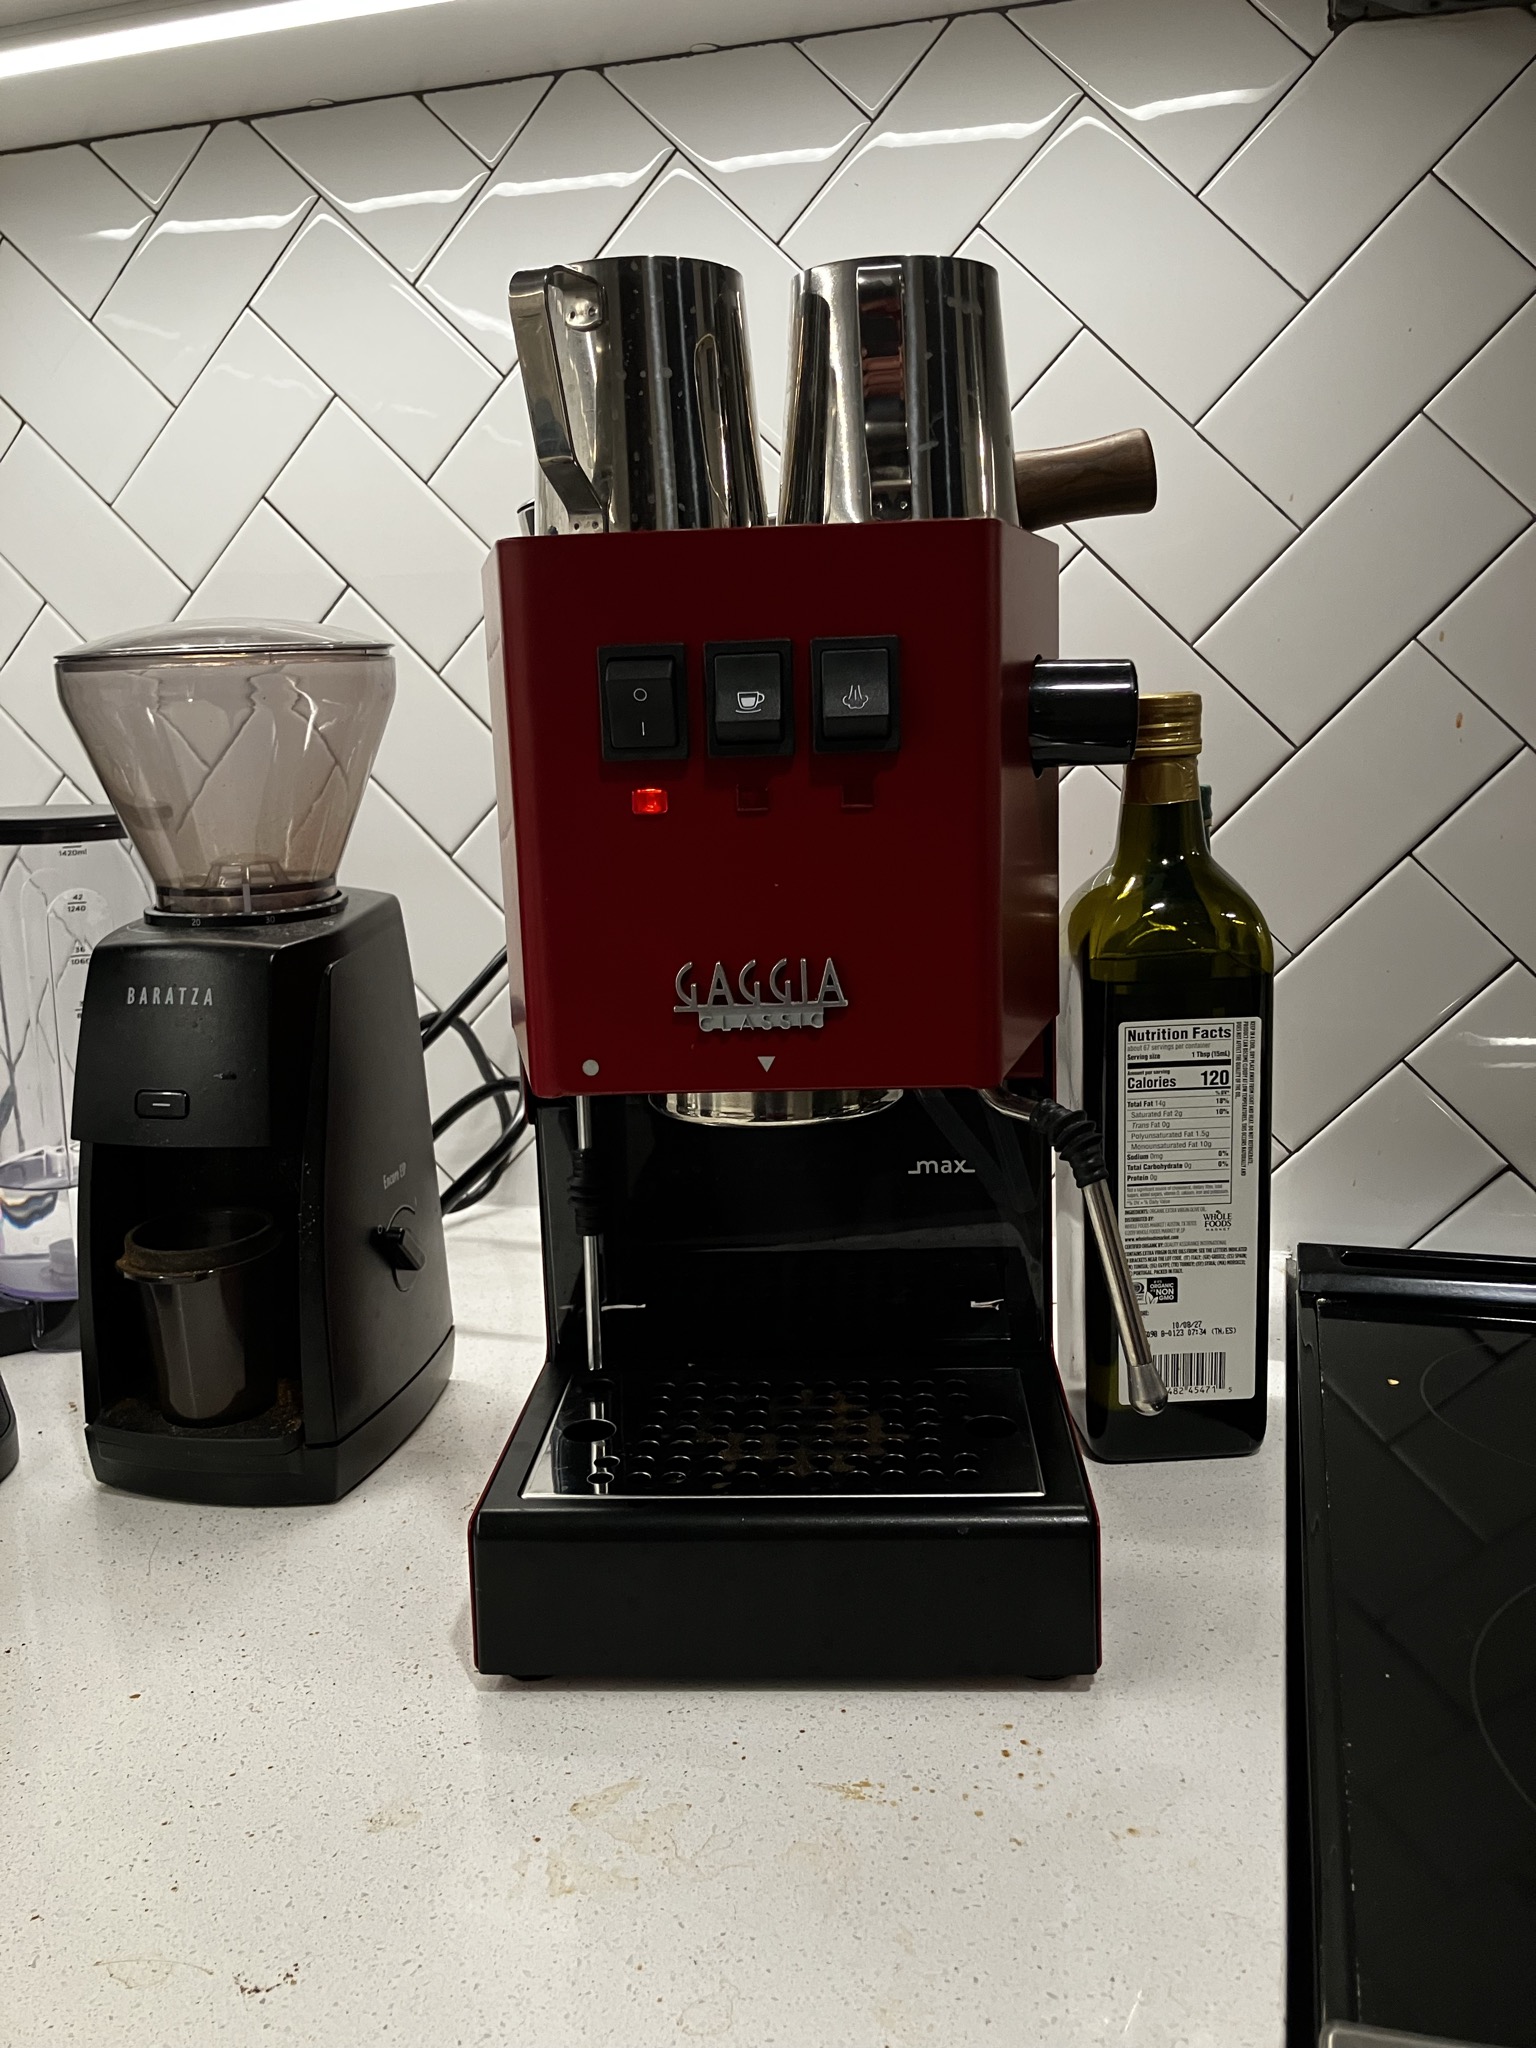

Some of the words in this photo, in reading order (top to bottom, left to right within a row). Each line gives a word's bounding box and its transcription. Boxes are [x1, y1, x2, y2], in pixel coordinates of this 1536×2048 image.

[191, 918, 201, 926] 20
[265, 916, 276, 924] 30
[673, 957, 848, 1012] GAGGIA
[127, 987, 213, 1006] BARATZA
[700, 1013, 824, 1032] CLASSIC
[1128, 1028, 1188, 1042] Nutrition
[1193, 1026, 1231, 1039] Facts
[1211, 1050, 1230, 1058] (15mL)
[1128, 1076, 1176, 1089] Calories
[1201, 1070, 1229, 1086] 120
[1131, 1132, 1182, 1140] Polyunsaturated
[1131, 1142, 1186, 1150] Monounsaturated
[913, 1160, 970, 1174] max
[1172, 1321, 1202, 1329] 10/08/27
[1188, 1328, 1206, 1336] 07:34
[1188, 1386, 1216, 1394] 45471
